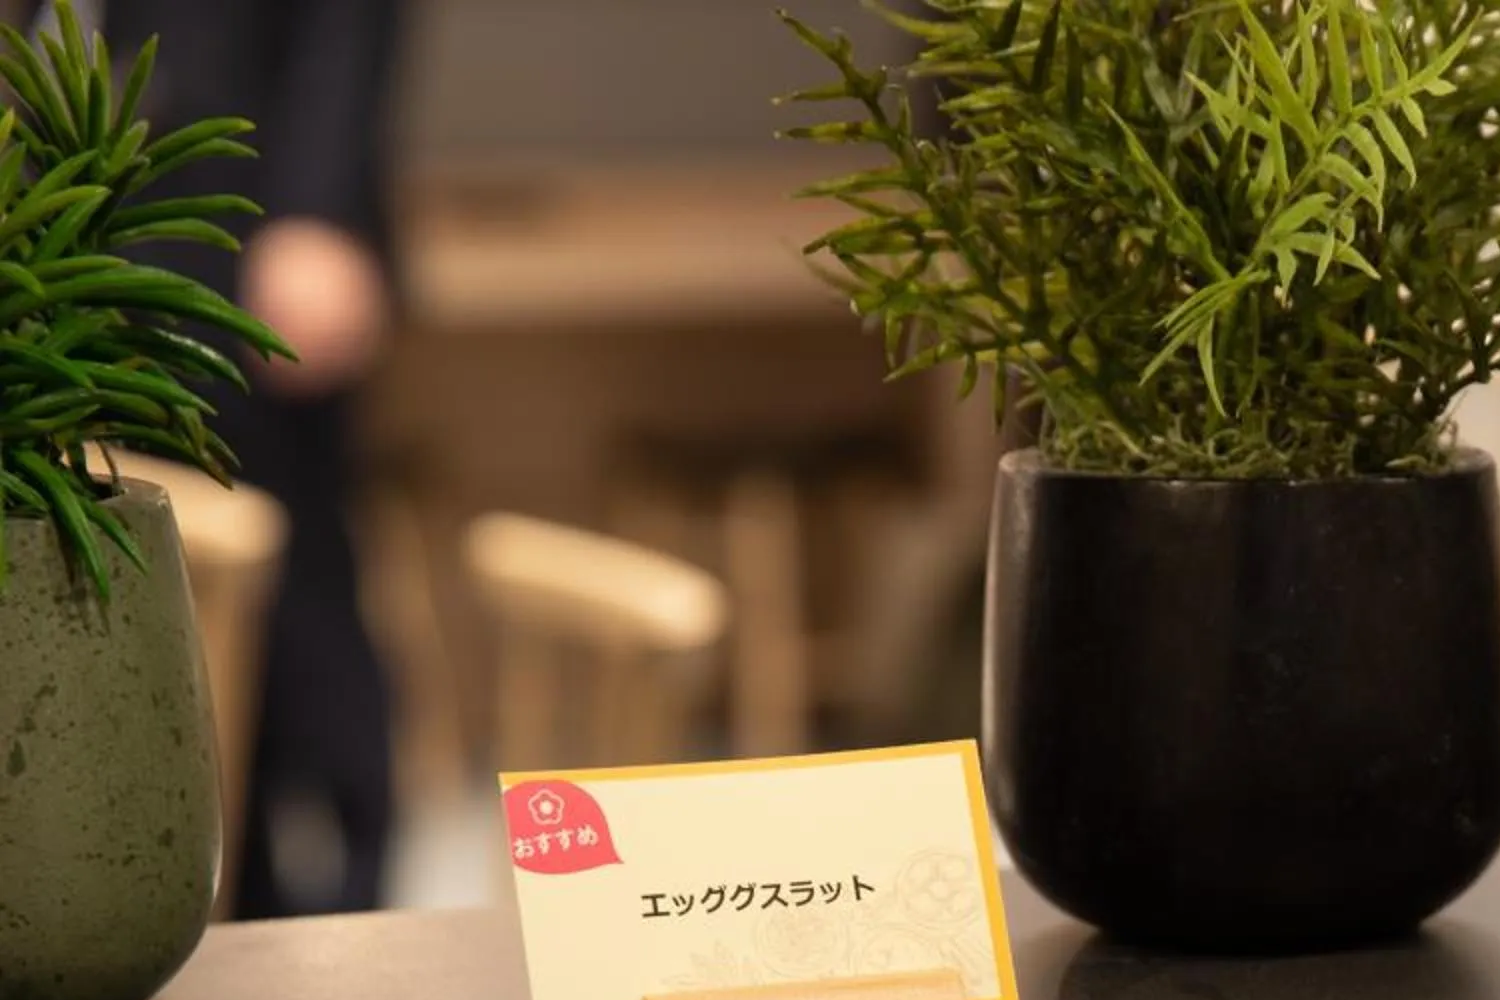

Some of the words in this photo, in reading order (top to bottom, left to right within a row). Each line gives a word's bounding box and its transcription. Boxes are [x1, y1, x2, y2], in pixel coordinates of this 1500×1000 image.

[513, 824, 599, 859] おすすめ
[640, 874, 876, 919] エッググスラット
